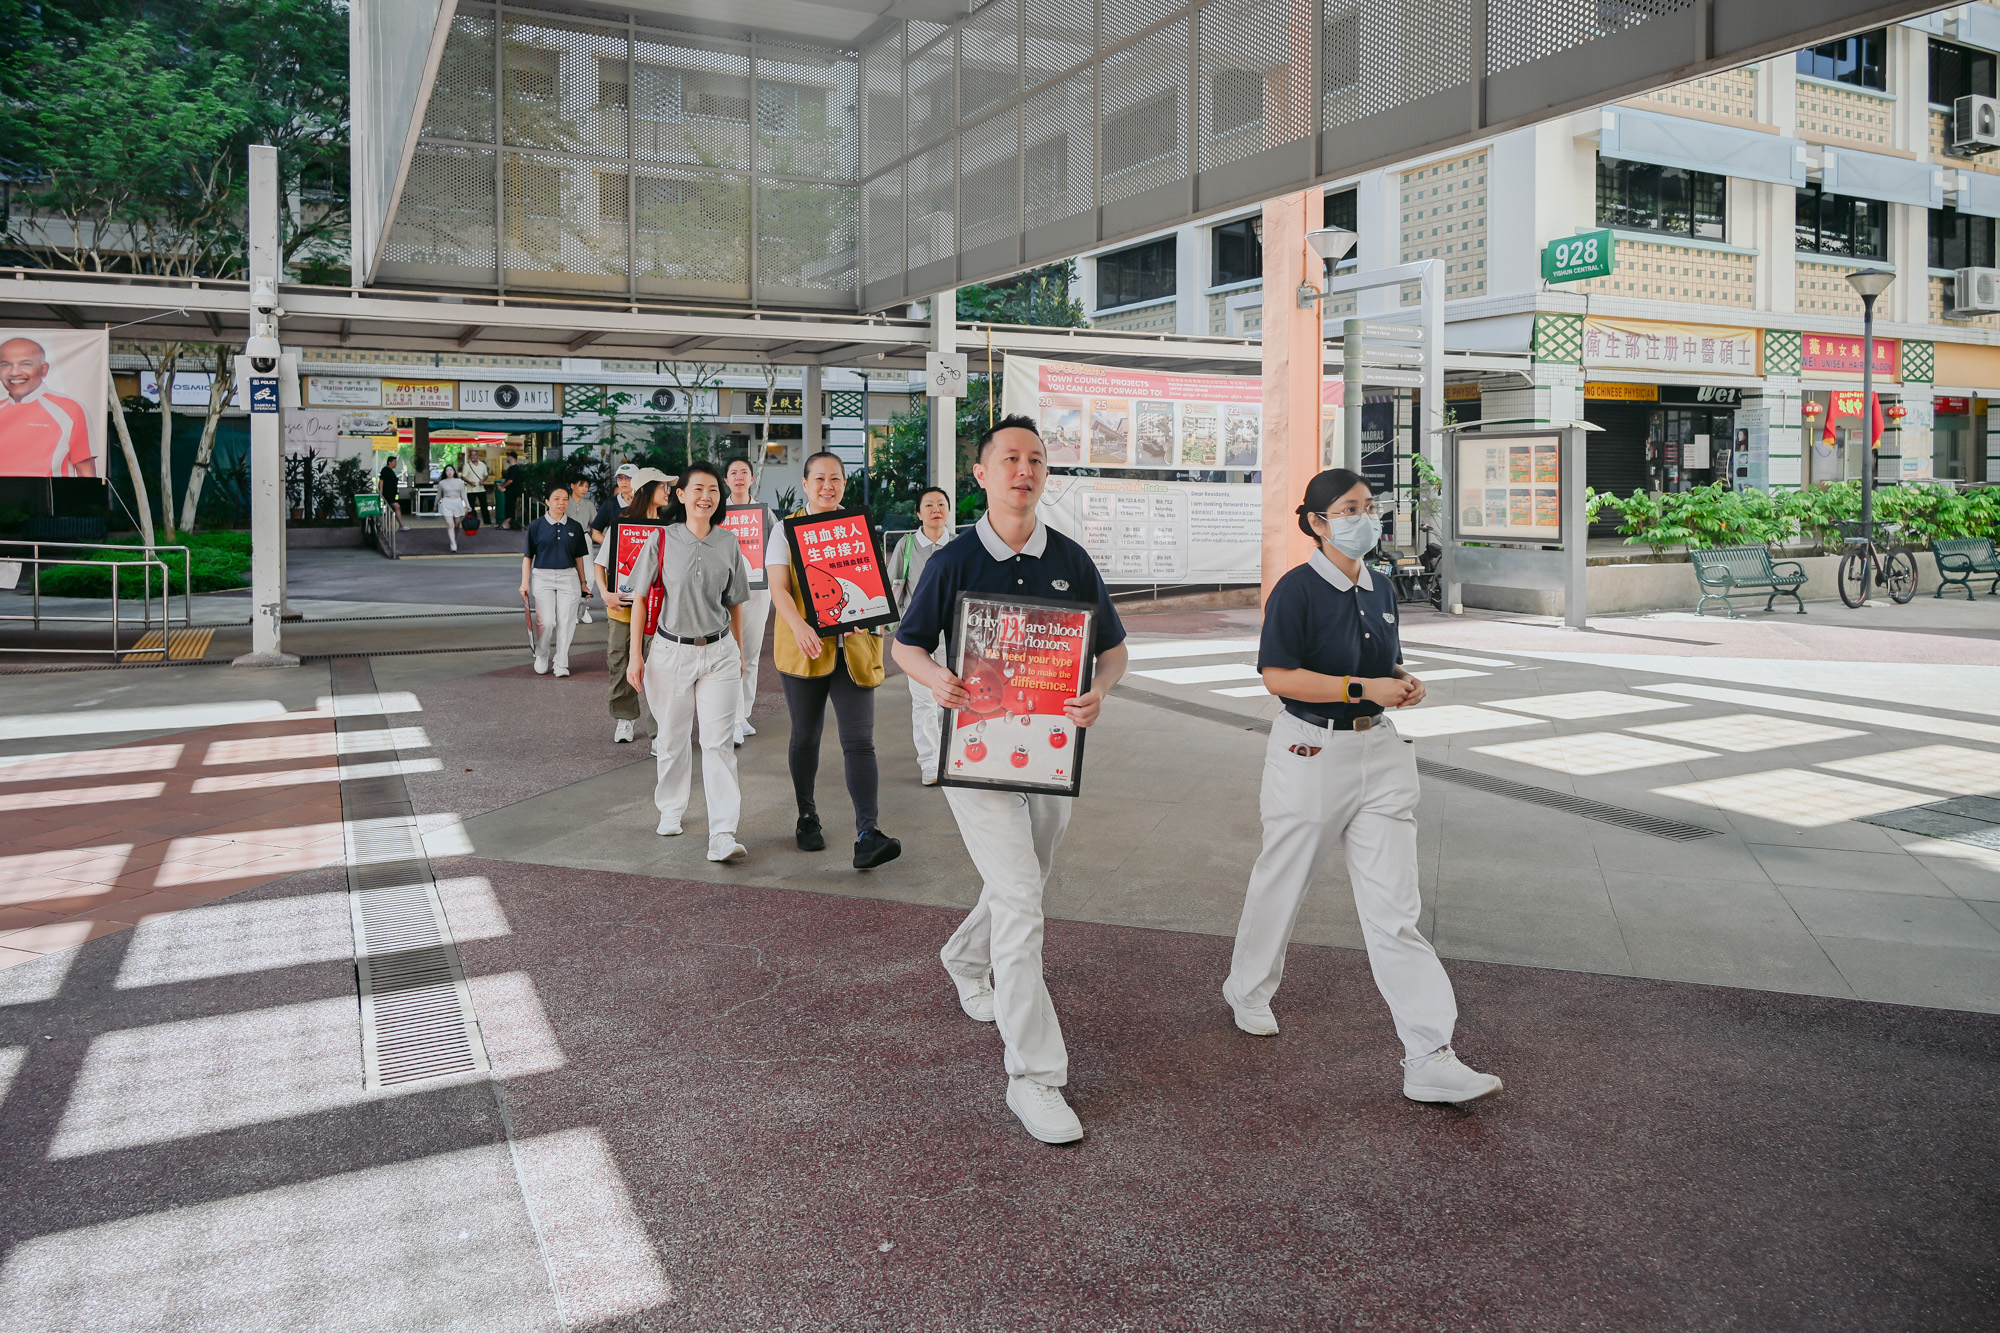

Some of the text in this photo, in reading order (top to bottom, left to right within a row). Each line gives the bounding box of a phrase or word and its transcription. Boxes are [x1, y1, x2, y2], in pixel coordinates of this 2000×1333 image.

[1555, 238, 1598, 268] 928
[1552, 268, 1573, 277] YISHUN
[1573, 264, 1600, 274] CENTRAL
[1809, 337, 1885, 359] 薇男女美屋
[1801, 357, 1816, 367] WEI
[1822, 360, 1845, 368] UNISEX
[1871, 362, 1892, 371] ALOON
[1047, 364, 1106, 377] UPCOMING
[1047, 375, 1149, 387] TOWN COUNCIL PROJECTS
[396, 385, 439, 393] #01-149
[1109, 387, 1148, 395] FORWARD
[1597, 386, 1622, 398] CHINESE
[1624, 387, 1655, 399] PHYSICIAN
[465, 391, 489, 402] JUST
[525, 391, 549, 404] ANTS
[683, 396, 705, 407] ATS
[1039, 397, 1053, 407] 20
[1095, 400, 1107, 409] 25
[1142, 402, 1148, 411] 7
[1185, 404, 1192, 414] 3
[1228, 406, 1239, 415] 22
[1361, 430, 1384, 440] MADRAS
[1361, 443, 1385, 452] BARBERS
[1093, 482, 1168, 492] House Visit Dates
[731, 526, 759, 537] 命接力
[803, 523, 862, 545] 捐血救人
[808, 540, 866, 562] 生命接力
[829, 556, 871, 569] 响应捐血就在
[968, 613, 1084, 642] Only 1% are blood
[1024, 635, 1071, 652] donors.
[984, 648, 1073, 668] We need your type
[1028, 668, 1071, 679] to make the
[1011, 675, 1076, 692] difference...
